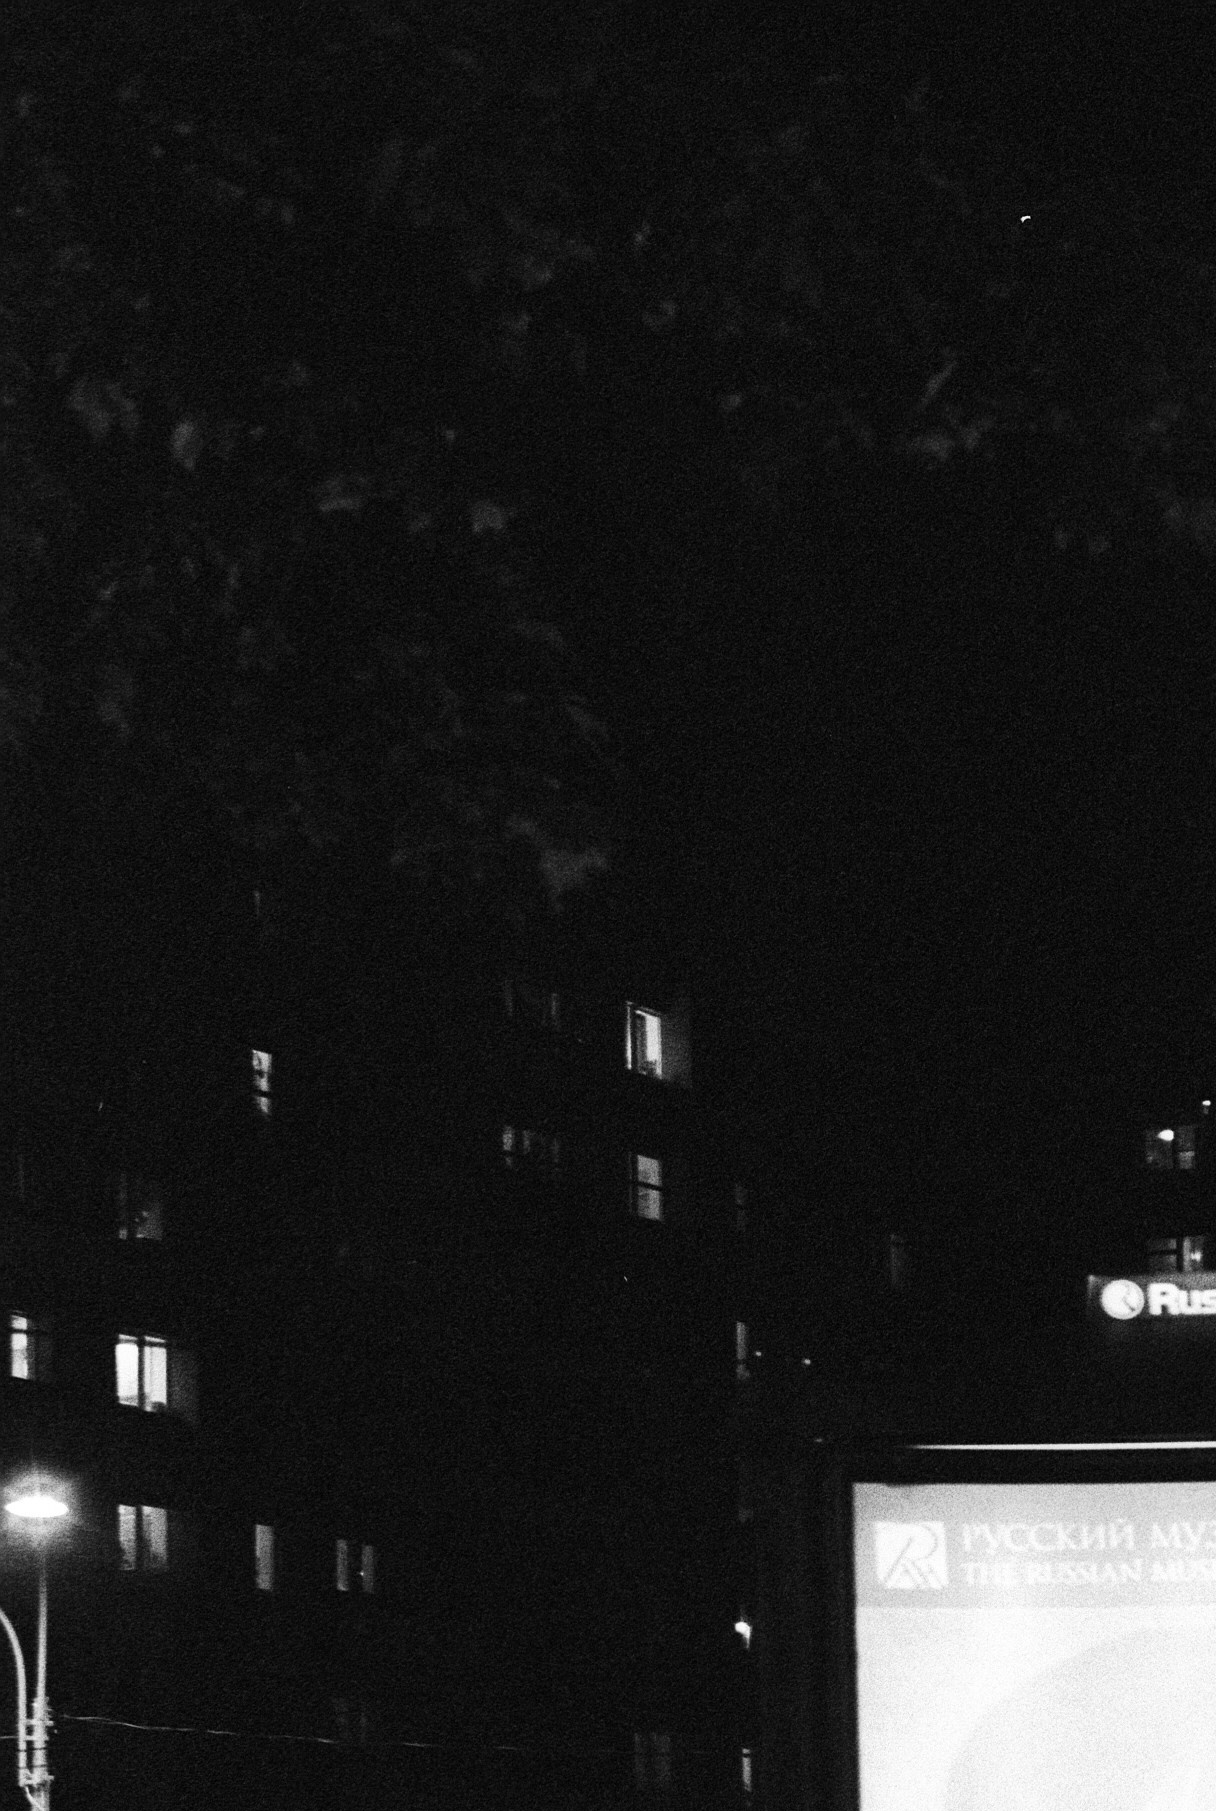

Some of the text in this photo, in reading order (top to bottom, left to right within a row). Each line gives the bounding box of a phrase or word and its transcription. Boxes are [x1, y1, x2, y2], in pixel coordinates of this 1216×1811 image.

[962, 1517, 1135, 1555] РУССКИЙ
[960, 1560, 1019, 1586] THE
[1026, 1559, 1143, 1585] RUSSIAN
